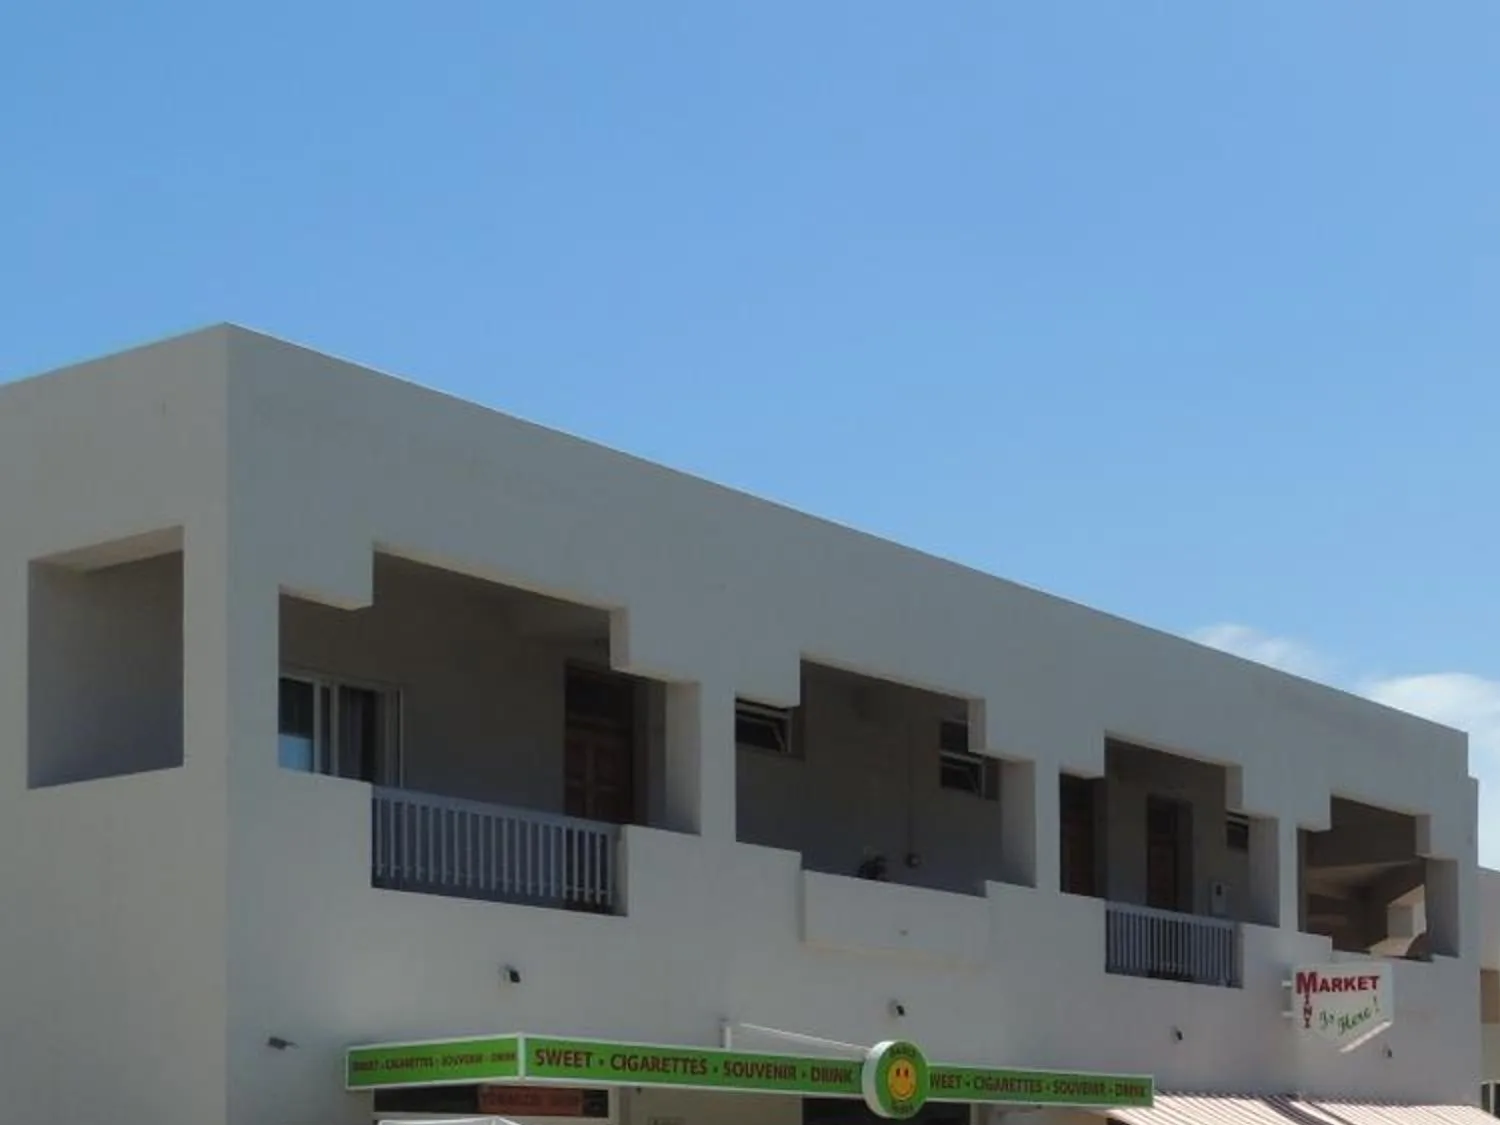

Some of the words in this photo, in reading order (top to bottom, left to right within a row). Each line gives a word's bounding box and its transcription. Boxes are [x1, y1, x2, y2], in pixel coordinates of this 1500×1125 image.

[534, 1048, 593, 1069] SWEET
[610, 1053, 708, 1076] CIGARETTES
[723, 1059, 797, 1081] SOUVENIR
[810, 1065, 853, 1084] DRINK
[929, 1073, 962, 1090] WEET
[973, 1075, 1043, 1094] CIGARETTES
[1053, 1079, 1105, 1096] SOUVENIR
[1115, 1082, 1146, 1099] DRINK
